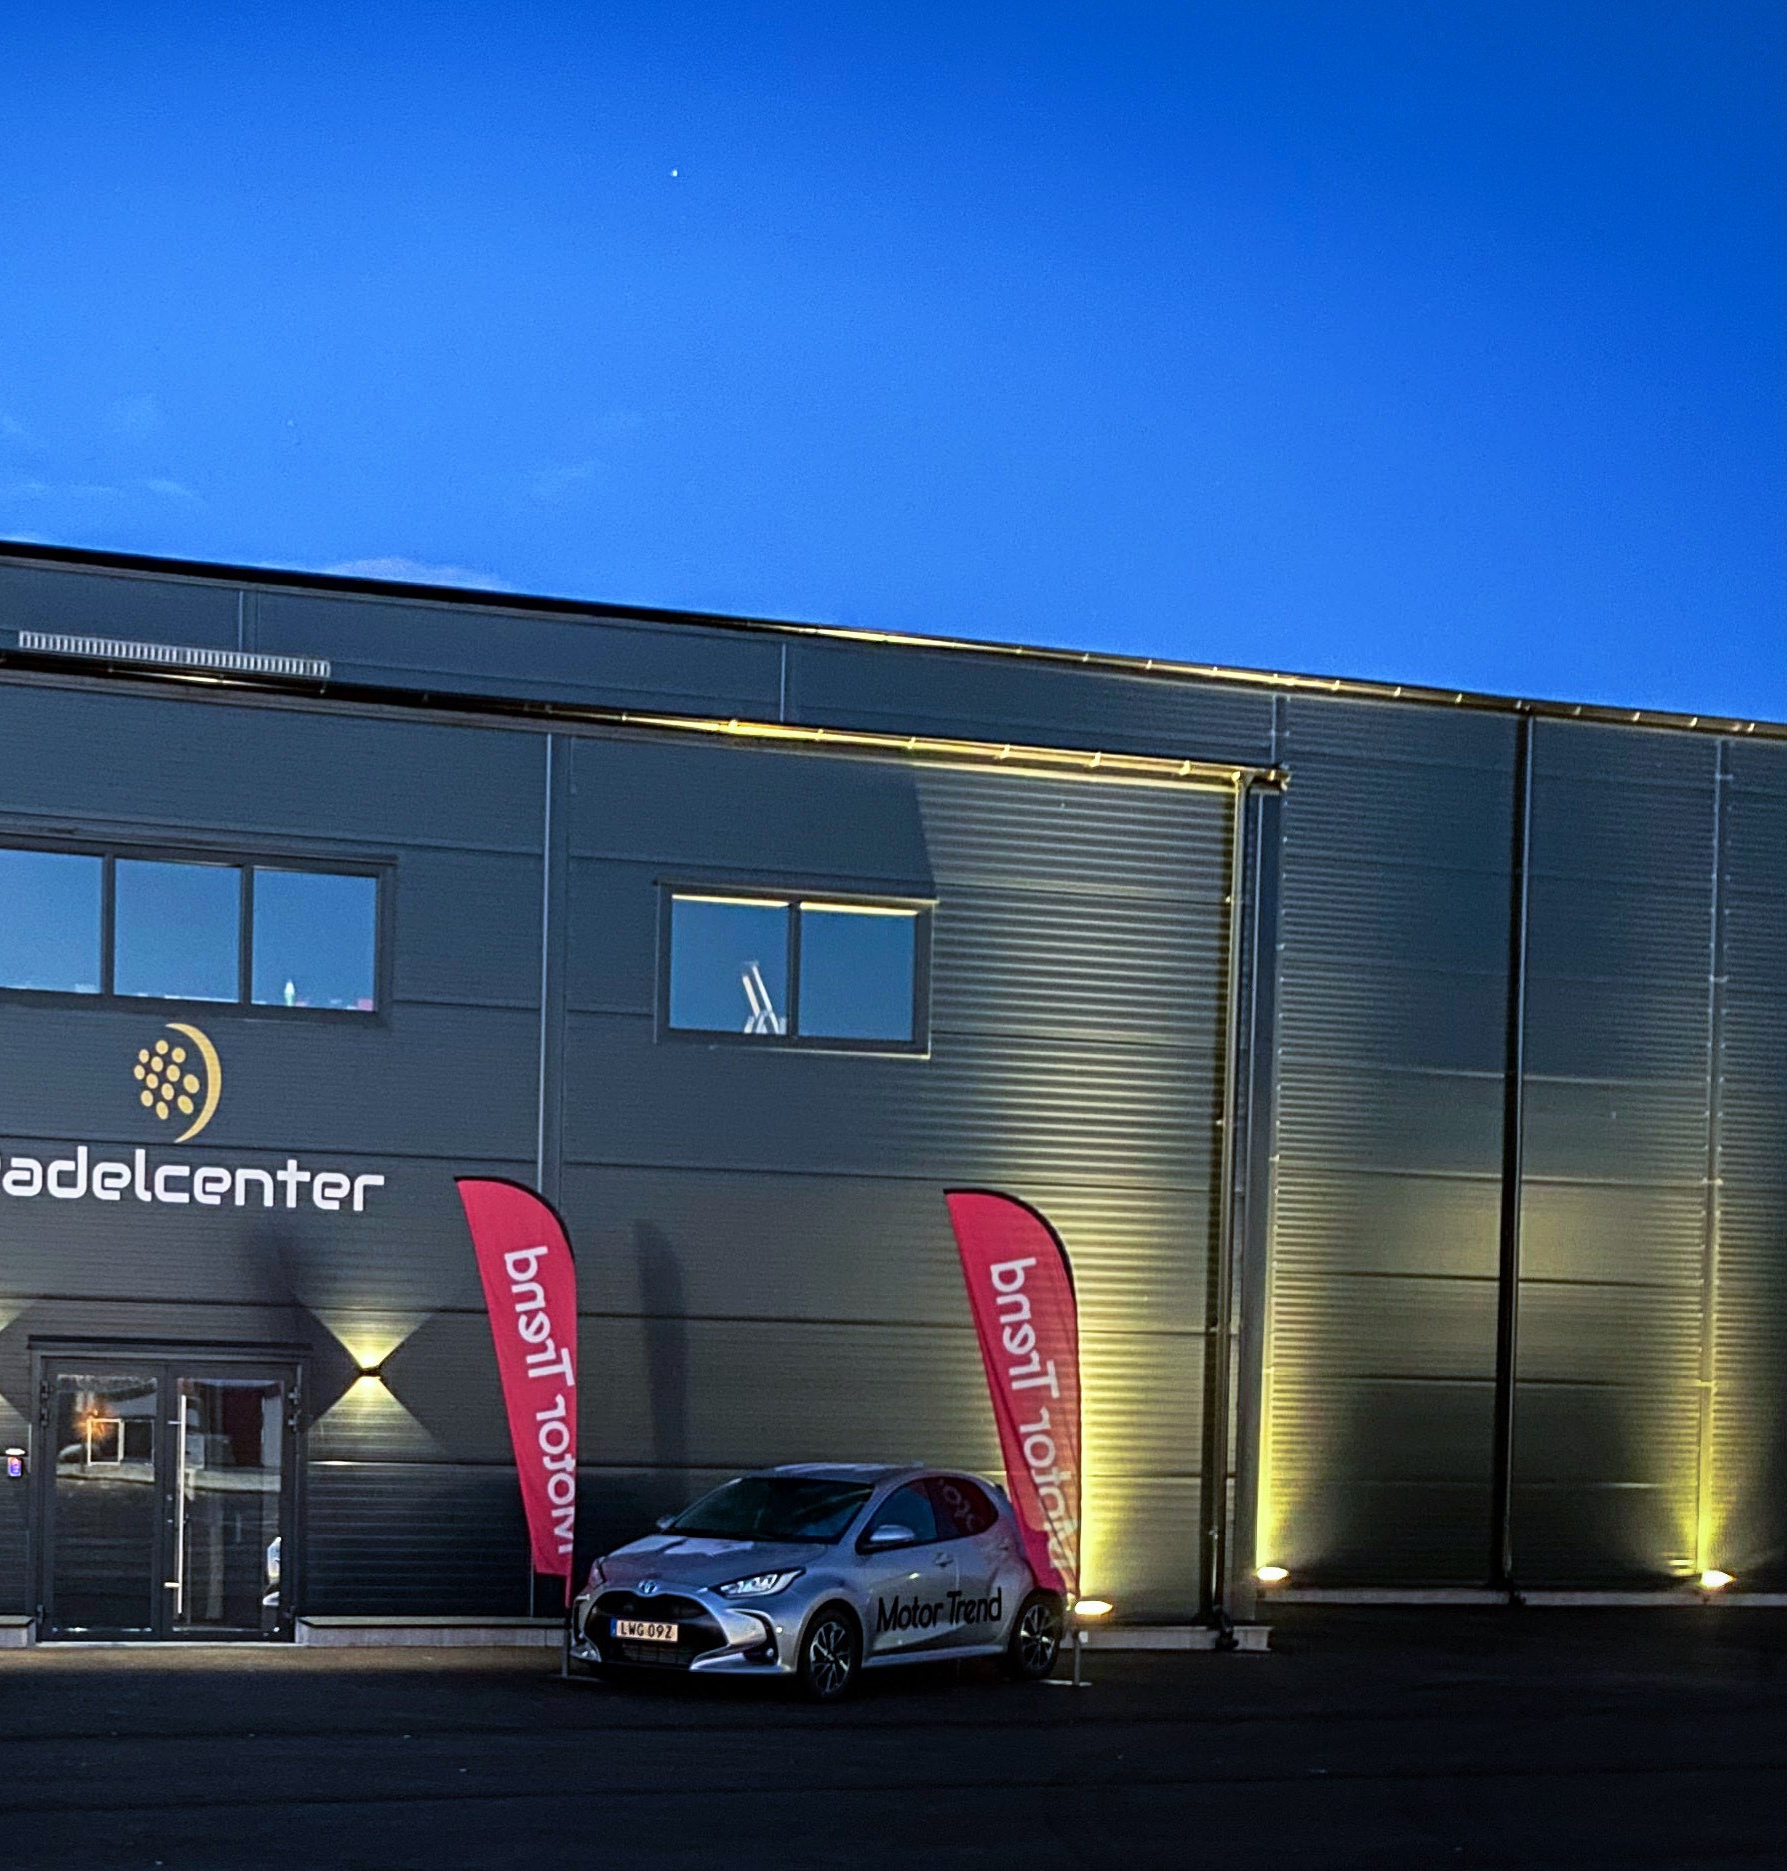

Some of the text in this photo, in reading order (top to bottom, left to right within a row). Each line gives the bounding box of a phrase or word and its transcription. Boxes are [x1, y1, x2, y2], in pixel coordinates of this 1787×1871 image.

[876, 1586, 1002, 1632] Motor Trend
[620, 1622, 645, 1637] LWG
